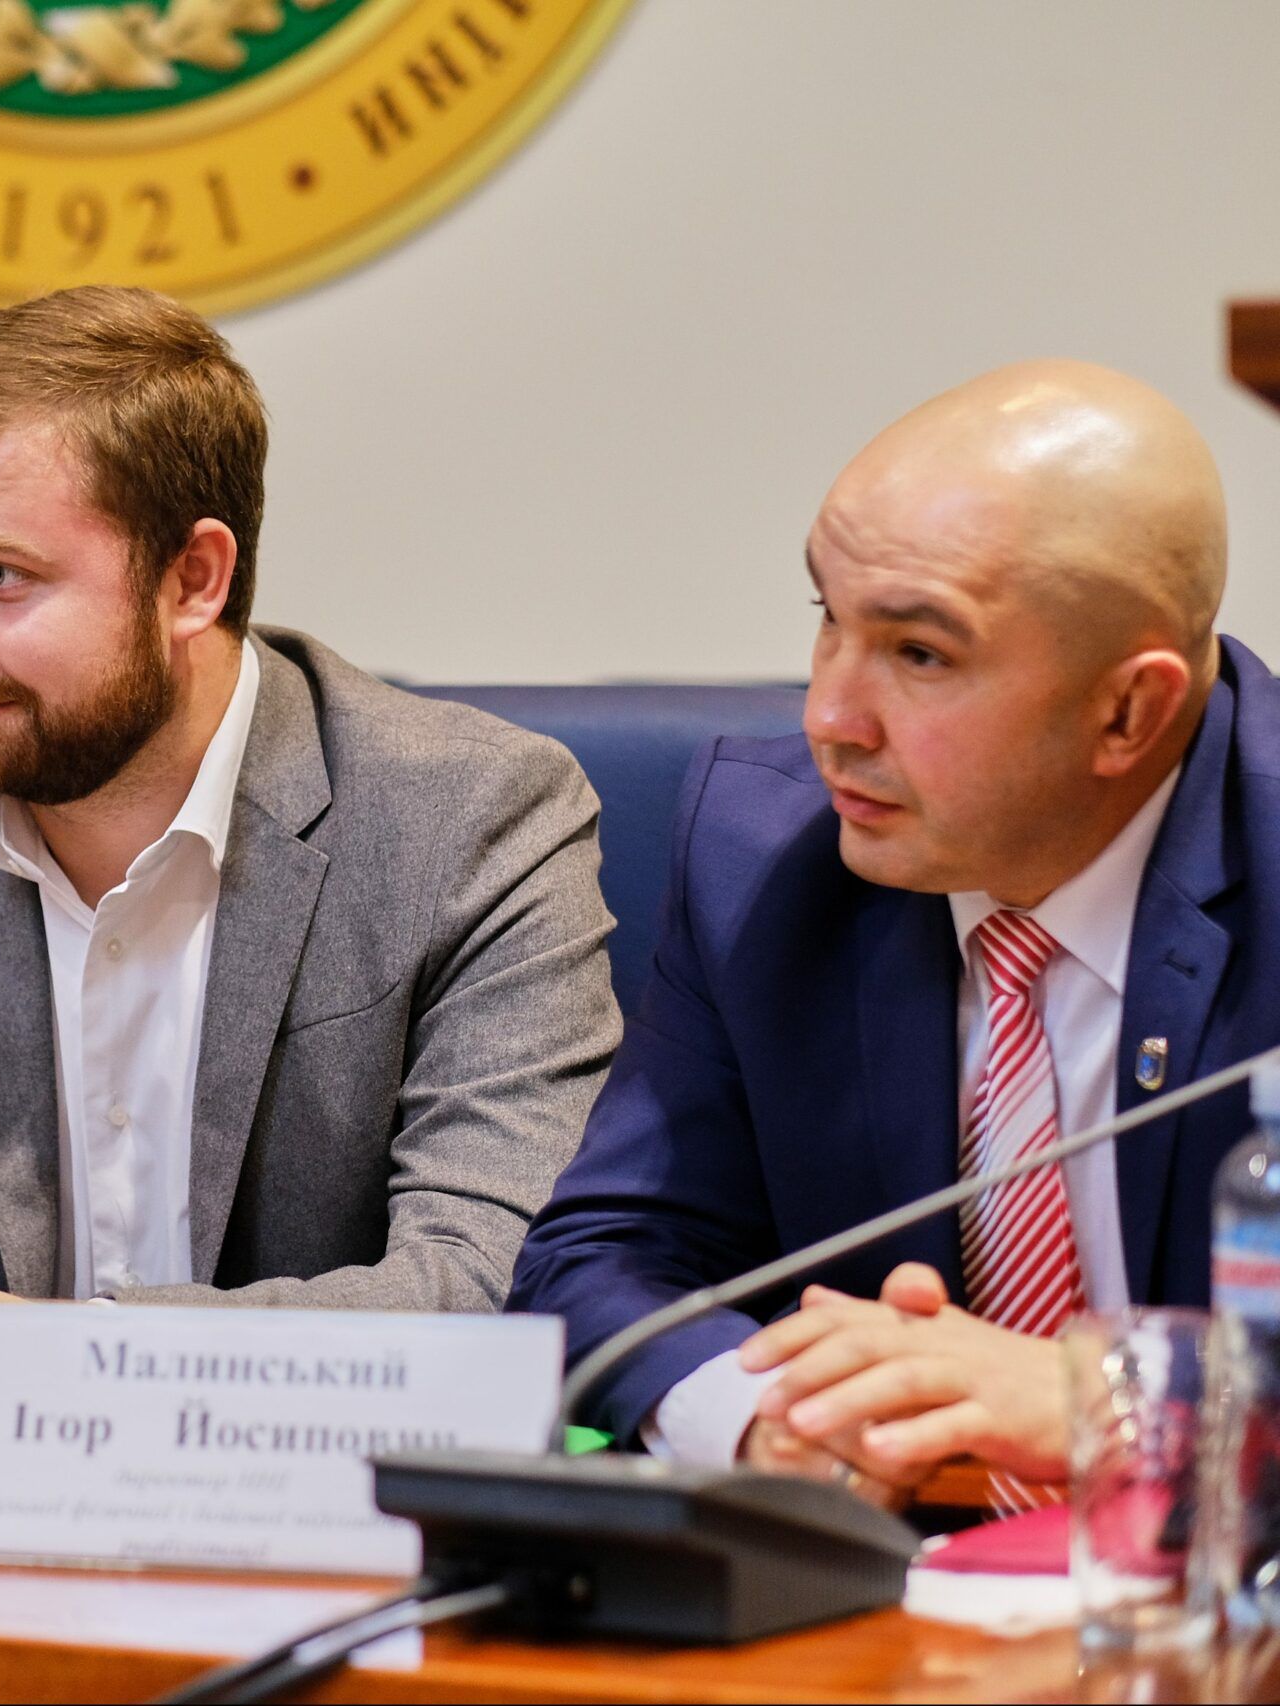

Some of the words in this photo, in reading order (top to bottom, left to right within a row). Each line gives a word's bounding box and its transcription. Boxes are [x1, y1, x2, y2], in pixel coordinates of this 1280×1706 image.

[0, 167, 243, 270] 1921
[81, 1339, 410, 1390] Малинський
[13, 1402, 113, 1455] Ігор
